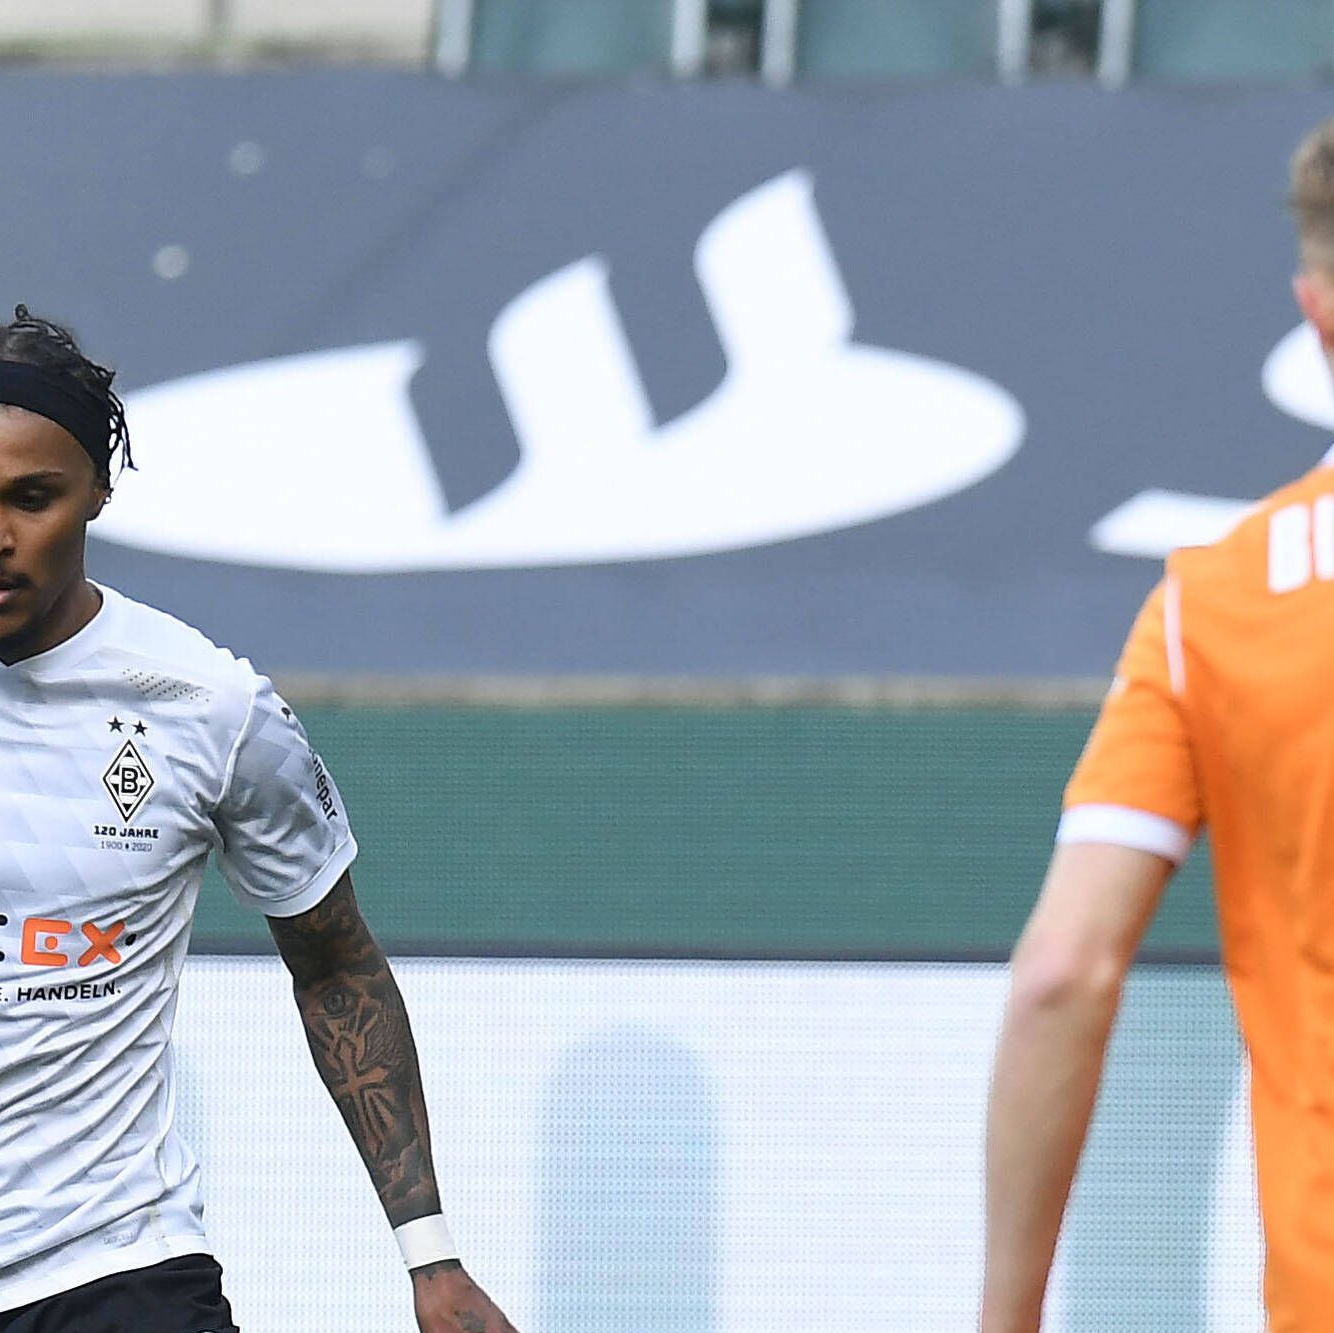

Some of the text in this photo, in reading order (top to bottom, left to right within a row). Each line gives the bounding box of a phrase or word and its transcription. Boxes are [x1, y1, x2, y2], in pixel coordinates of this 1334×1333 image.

[307, 748, 338, 820] onepar
[94, 825, 159, 839] 120 JAHRE
[16, 981, 122, 1002] HANDELN.
